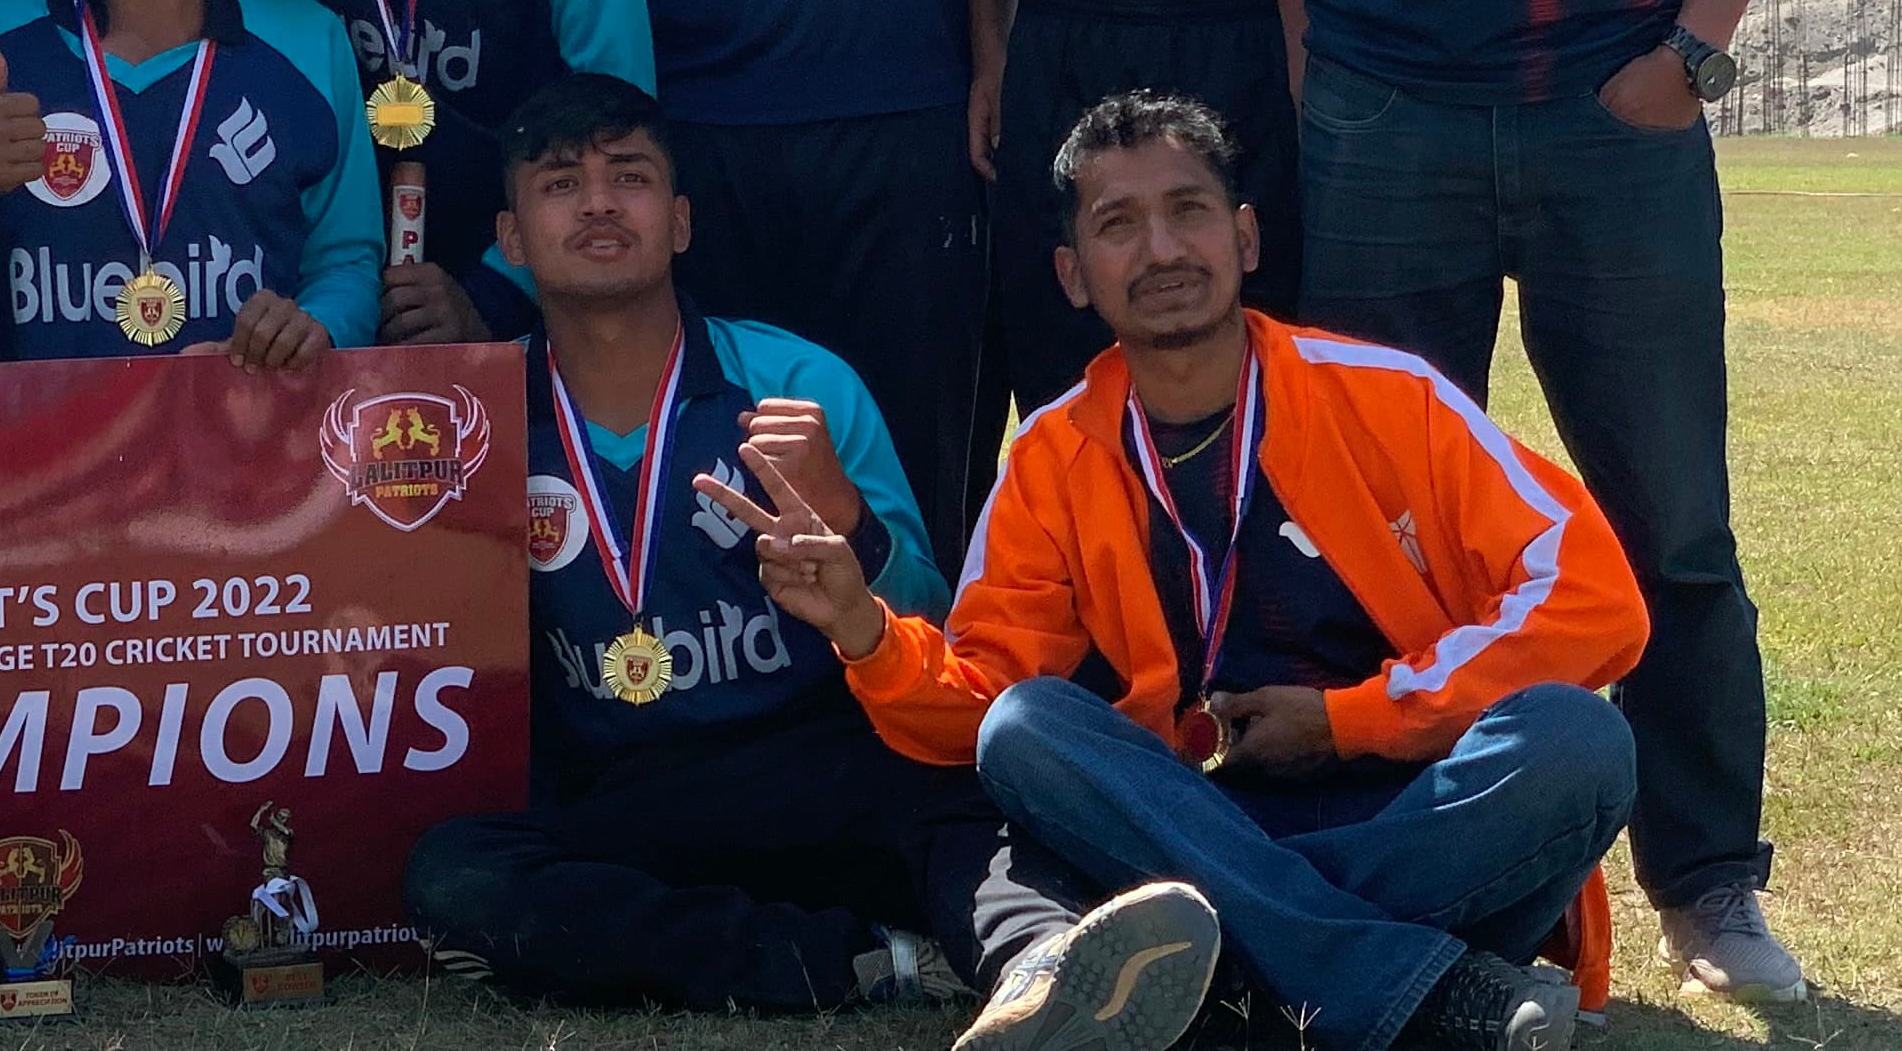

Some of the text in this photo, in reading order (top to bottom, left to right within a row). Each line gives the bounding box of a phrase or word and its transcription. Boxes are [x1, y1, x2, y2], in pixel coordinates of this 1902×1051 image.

[57, 142, 80, 152] CUP
[349, 458, 464, 490] LALITPUR
[375, 483, 438, 498] PATRIOTS
[529, 496, 573, 510] TRIOTS
[532, 507, 555, 517] CUP
[74, 579, 177, 624] CUP
[191, 573, 312, 619] 2022
[41, 642, 97, 668] T20
[105, 634, 231, 665] CRICKET
[238, 622, 450, 658] TOURNAMENT
